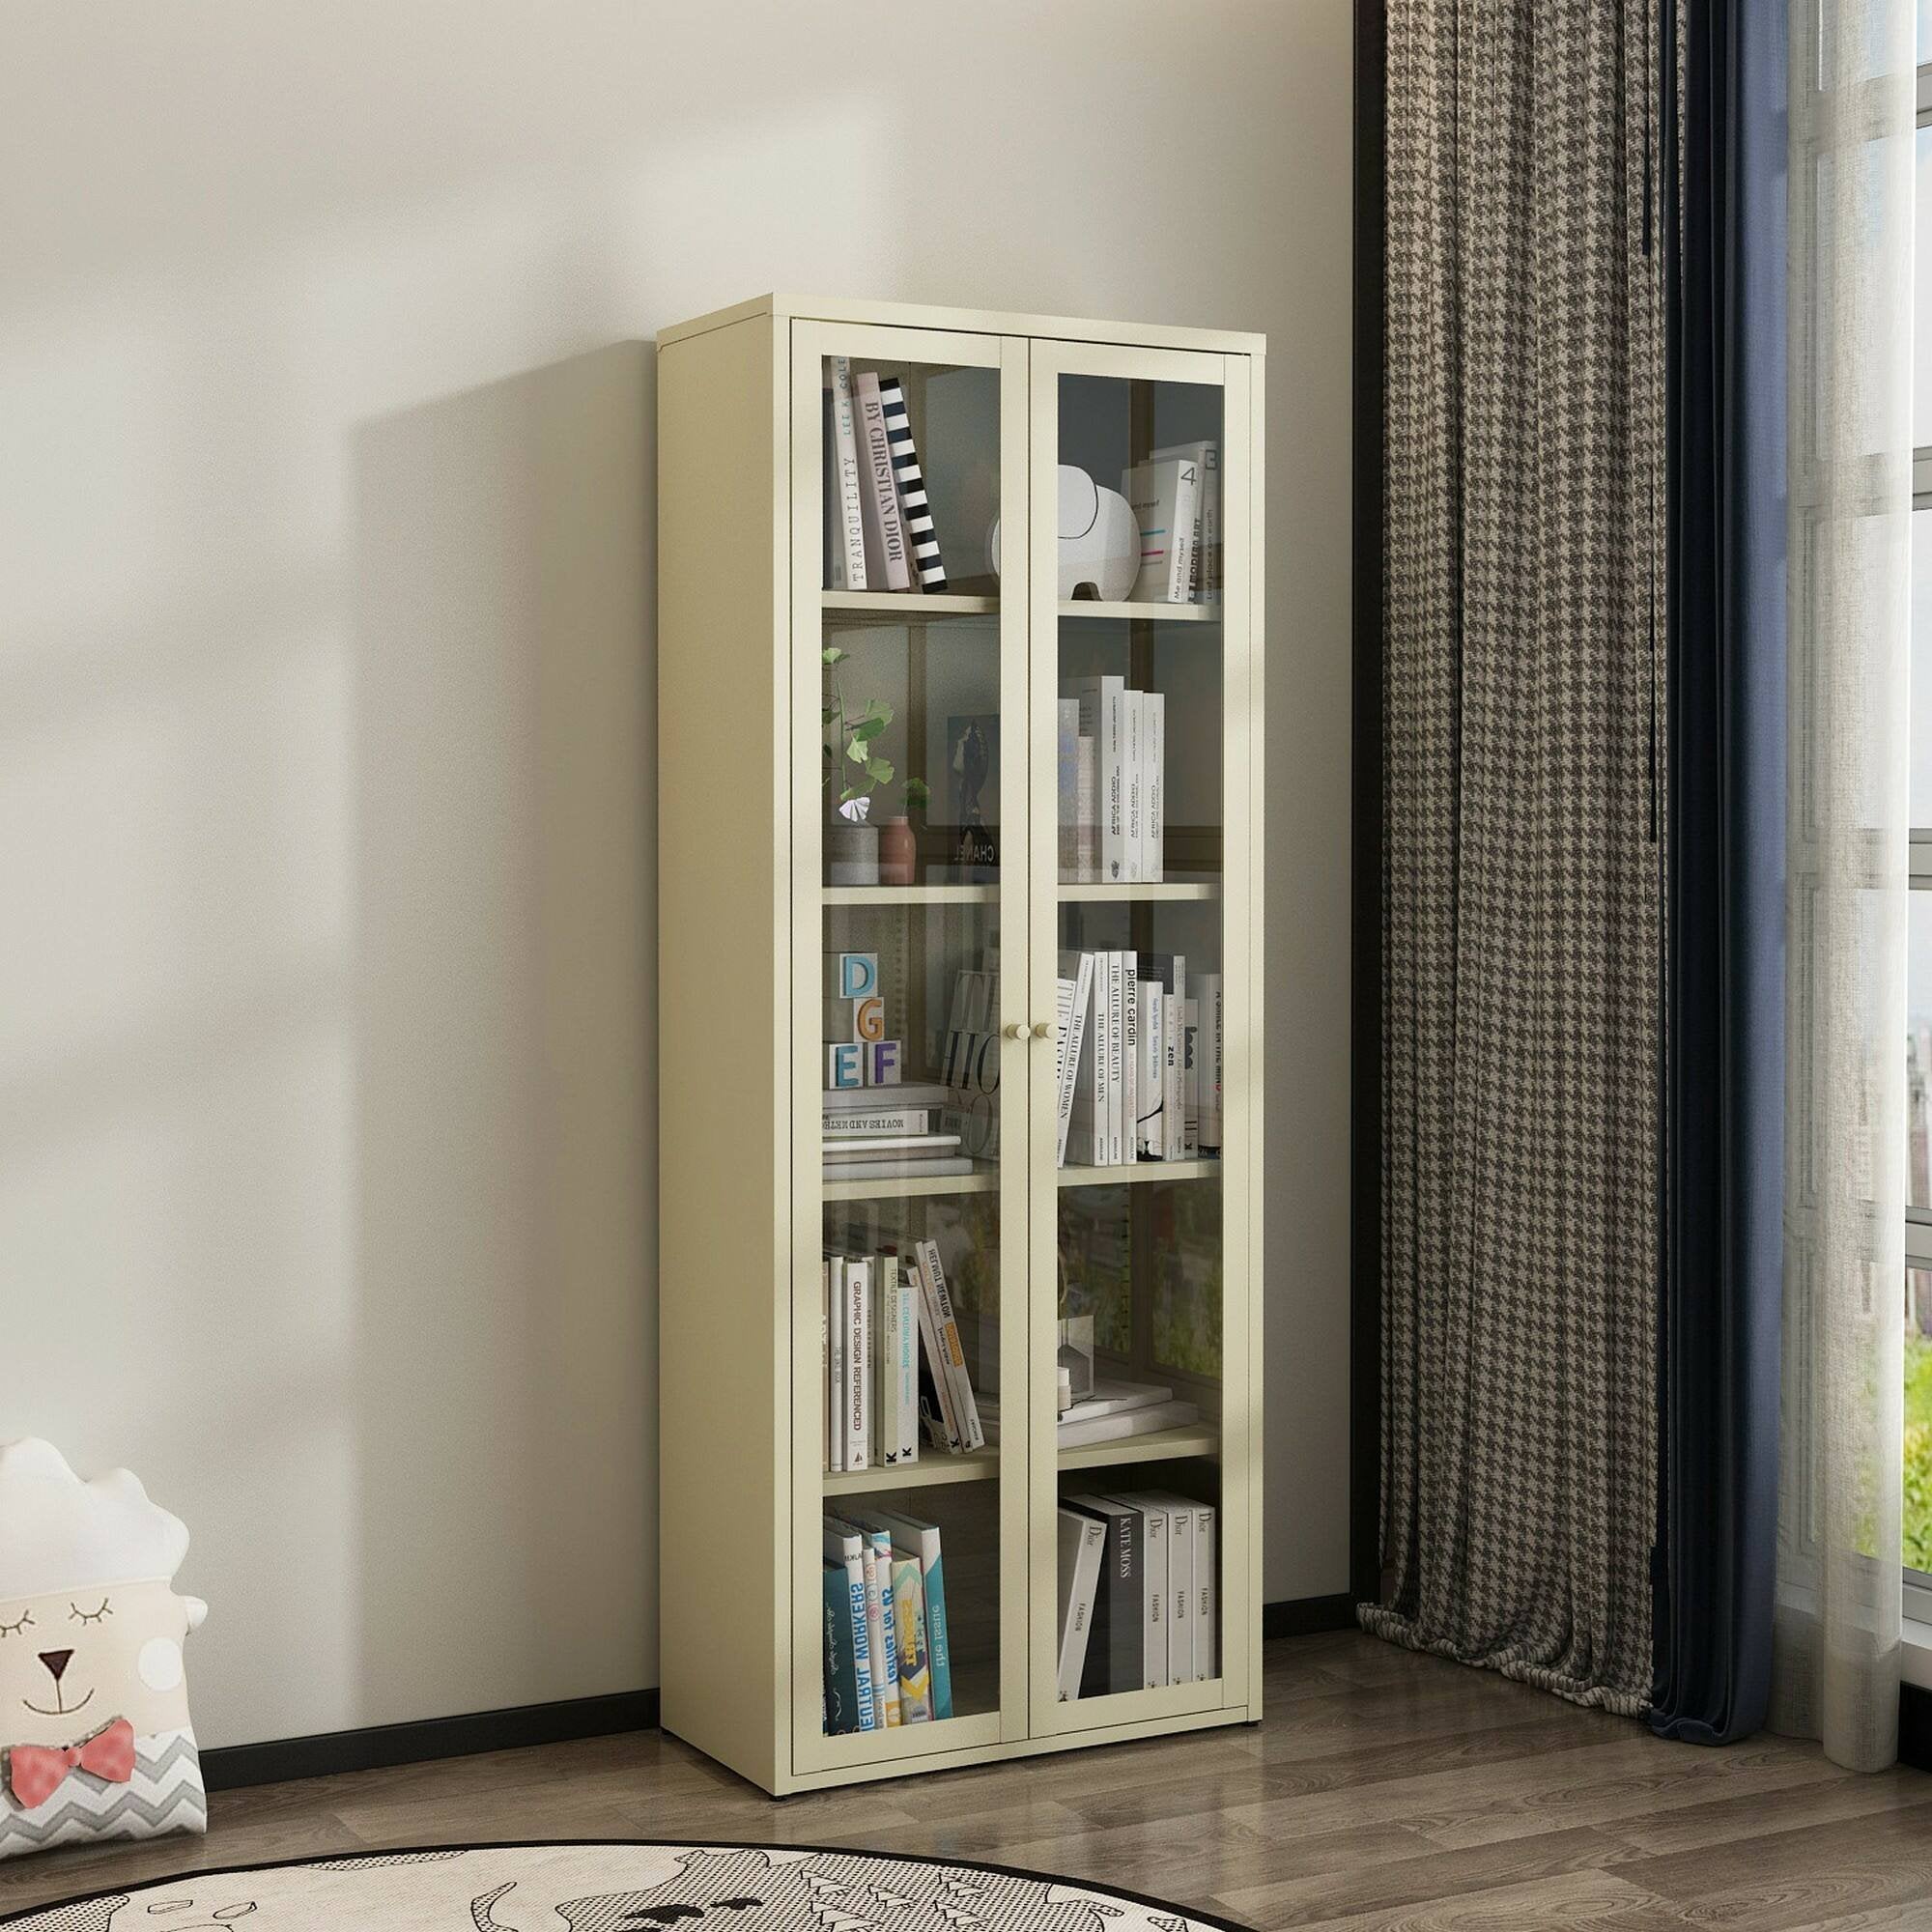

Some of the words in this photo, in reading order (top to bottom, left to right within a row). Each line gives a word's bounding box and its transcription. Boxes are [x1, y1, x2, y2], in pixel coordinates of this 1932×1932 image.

[837, 358, 850, 389] COLE
[865, 401, 882, 422] BY
[868, 426, 895, 517] CHRISTIAN
[1180, 467, 1197, 486] 4
[844, 458, 865, 582] TRANQUILITY
[883, 522, 903, 563] DIOR
[842, 955, 876, 997] D
[1112, 964, 1121, 984] THE
[1125, 969, 1136, 1005] pierre
[857, 998, 883, 1042] G
[1112, 986, 1121, 1026] ALLURE
[1072, 1013, 1083, 1031] THE
[1112, 1027, 1121, 1040] OF
[1127, 1008, 1137, 1046] cardin
[835, 1045, 859, 1088] E
[874, 1042, 897, 1084] F
[1065, 1031, 1079, 1068] ALLURE
[1111, 1042, 1121, 1082] BEAUTY
[1065, 1069, 1075, 1084] OF
[1060, 1084, 1072, 1120] WOMEN
[849, 1120, 868, 1129] AND
[868, 1120, 904, 1129] MOVIES
[853, 1281, 862, 1324] GRAPHIC
[853, 1327, 862, 1363] DESIGN
[853, 1366, 862, 1431] REFERENCED
[1087, 1525, 1103, 1547] Dior
[1120, 1518, 1131, 1548] KATE
[1150, 1519, 1163, 1539] Dior
[1175, 1515, 1188, 1536] Dior
[1199, 1513, 1211, 1533] Dior
[1120, 1548, 1132, 1578] MOSS
[1075, 1603, 1086, 1632] FASHION
